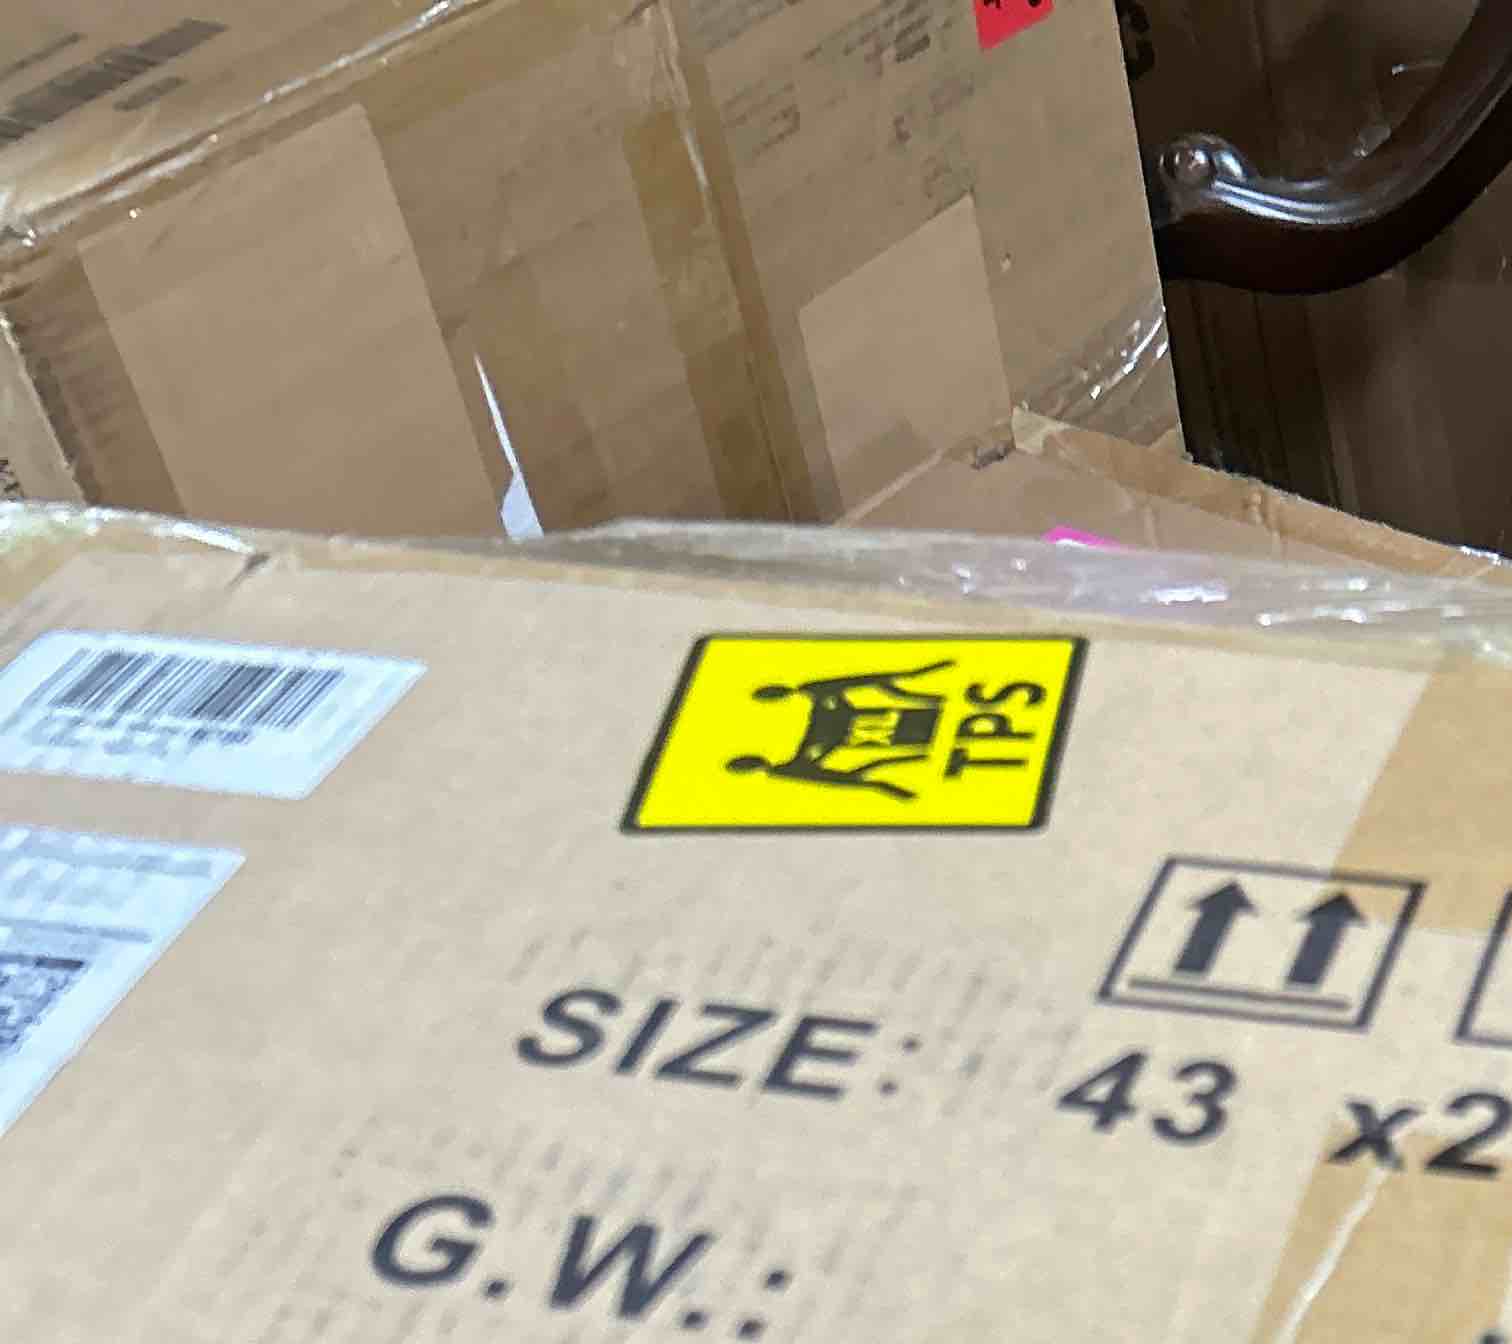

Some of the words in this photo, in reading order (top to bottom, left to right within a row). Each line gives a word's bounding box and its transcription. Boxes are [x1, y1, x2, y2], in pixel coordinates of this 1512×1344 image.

[943, 681, 1047, 779] TPS
[515, 986, 922, 1100] SIZE:
[1057, 1048, 1238, 1146] 43
